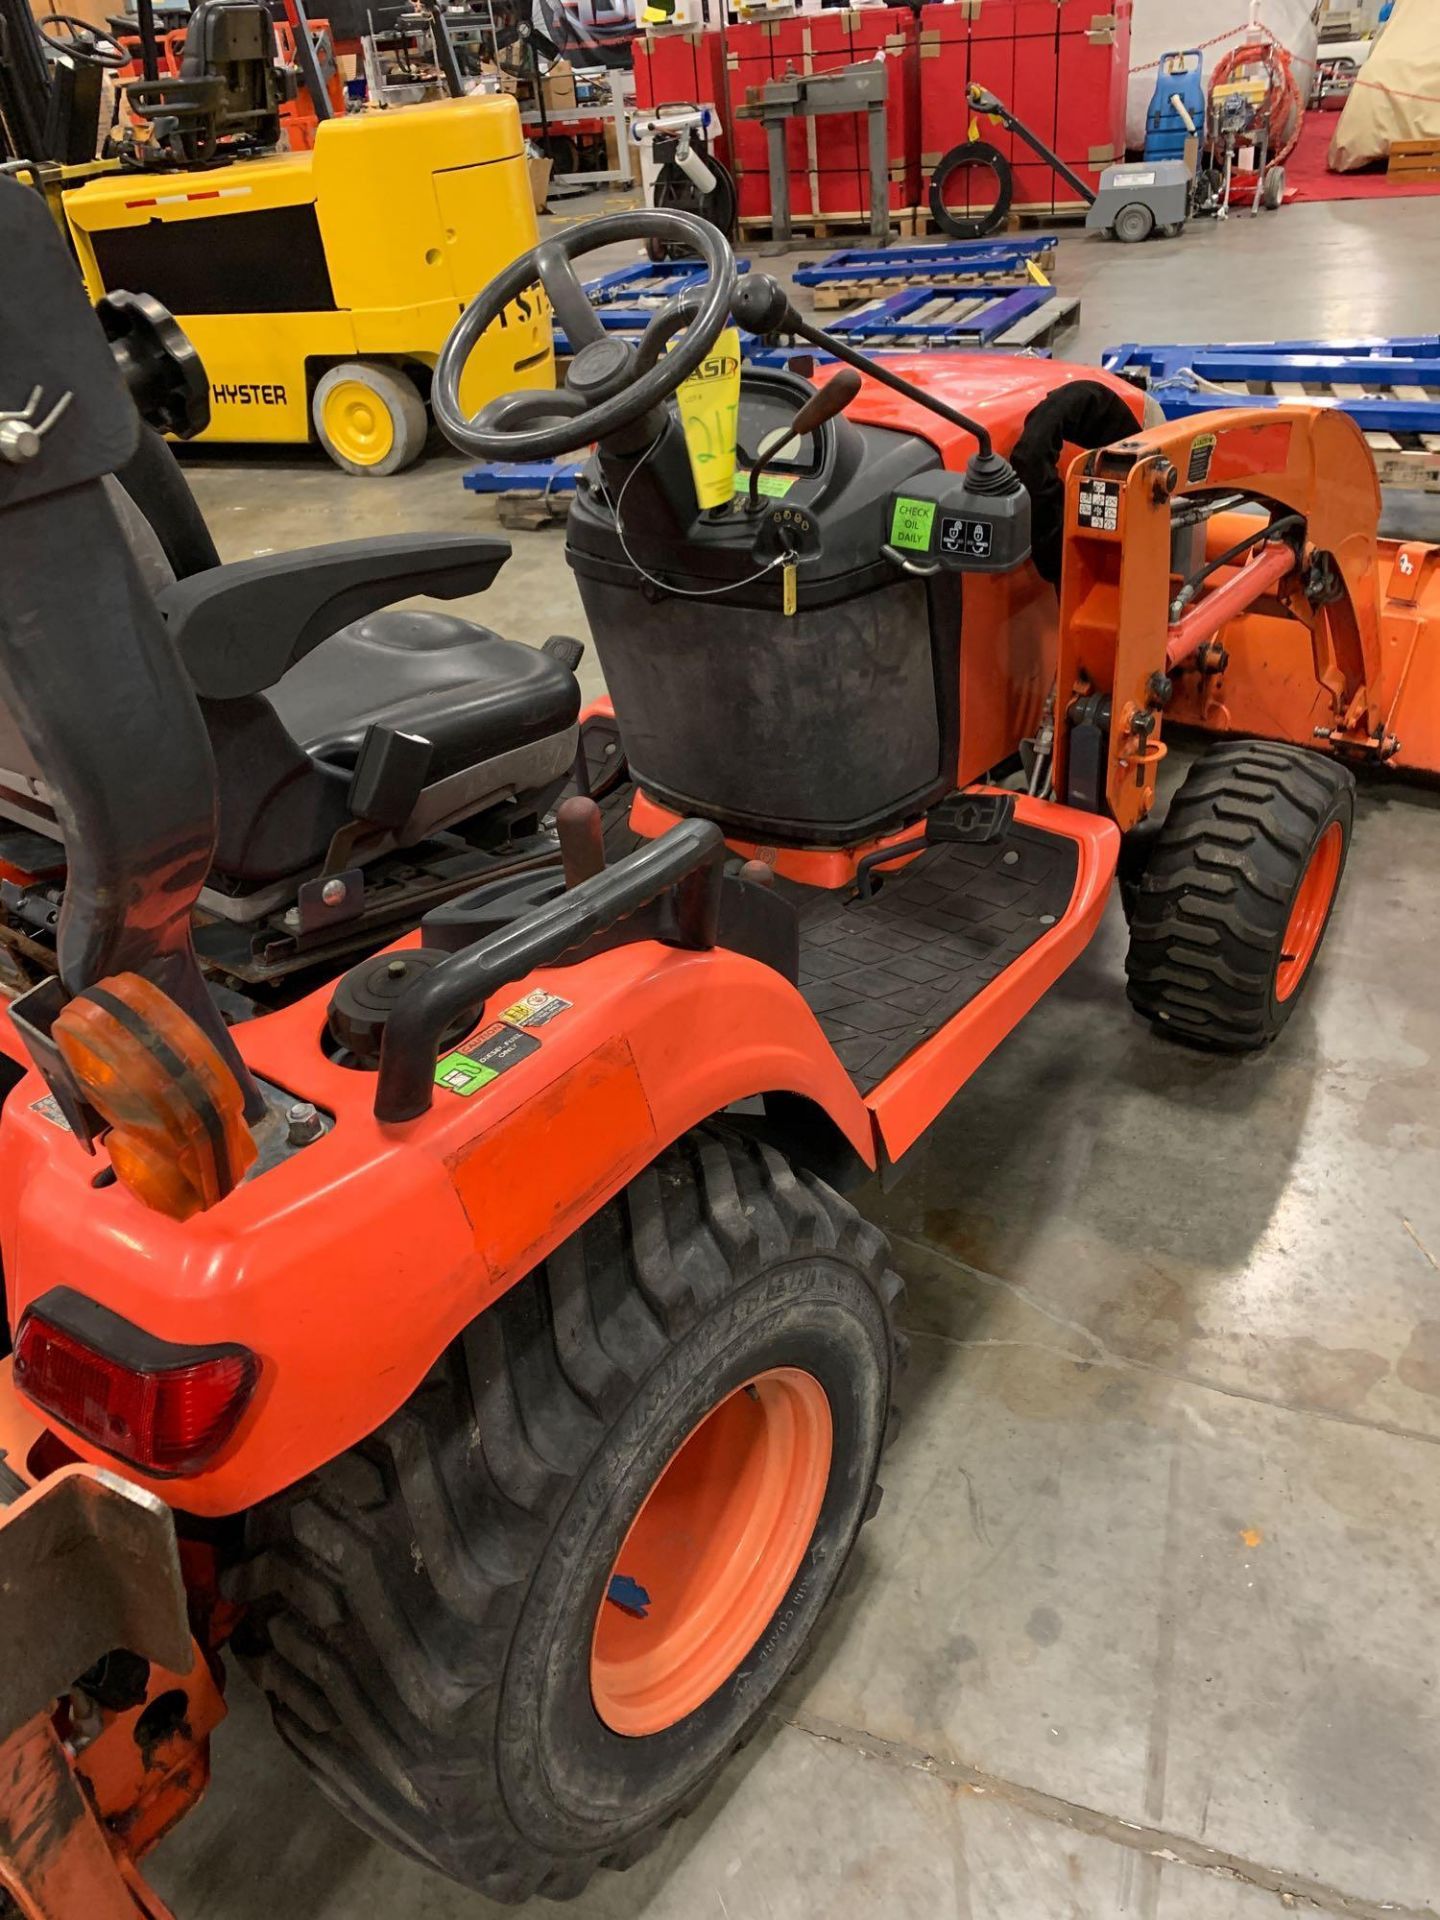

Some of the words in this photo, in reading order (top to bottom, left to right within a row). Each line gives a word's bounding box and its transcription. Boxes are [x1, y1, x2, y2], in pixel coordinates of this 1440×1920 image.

[212, 383, 287, 405] HYSTER
[899, 505, 929, 518] CHECK
[904, 519, 919, 530] OIL
[897, 531, 924, 544] DAILY
[462, 1023, 506, 1054] CAUTION
[498, 1043, 518, 1059] ONLY
